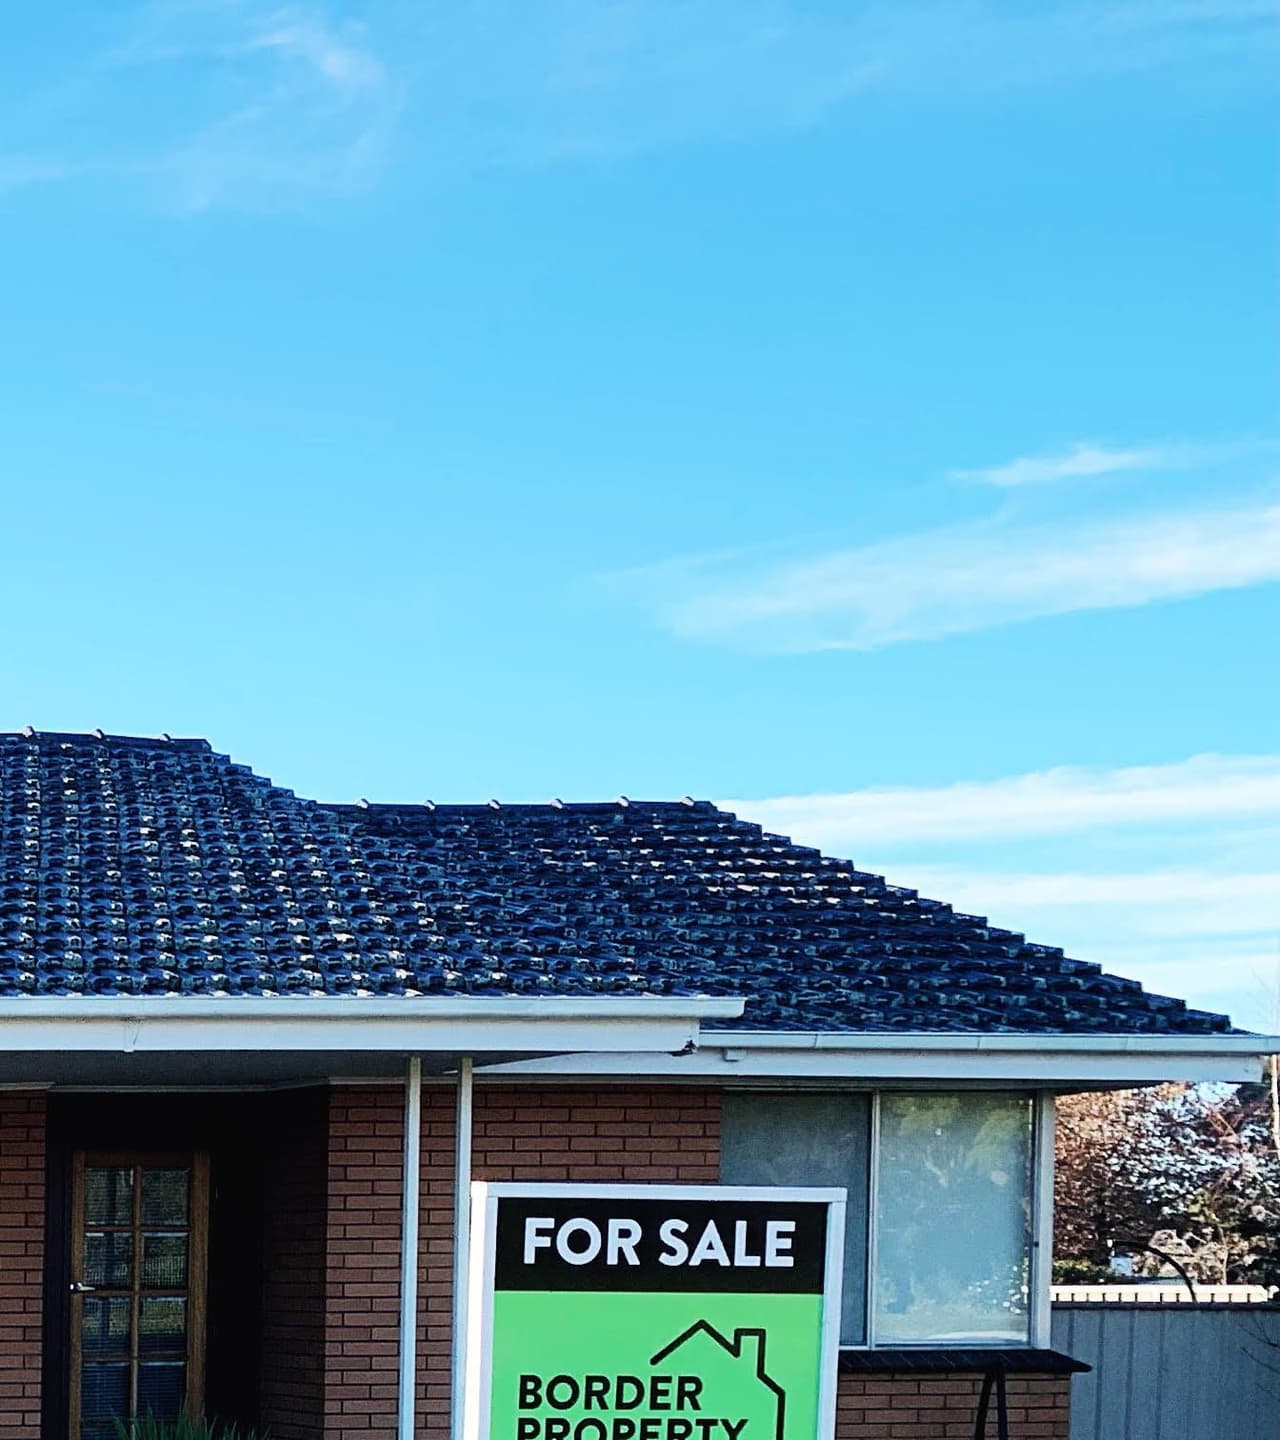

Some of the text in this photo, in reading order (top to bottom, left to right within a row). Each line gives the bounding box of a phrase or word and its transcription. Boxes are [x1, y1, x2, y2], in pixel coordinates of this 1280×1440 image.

[523, 1216, 797, 1268] FOR SALE
[517, 1374, 704, 1412] BORDER
